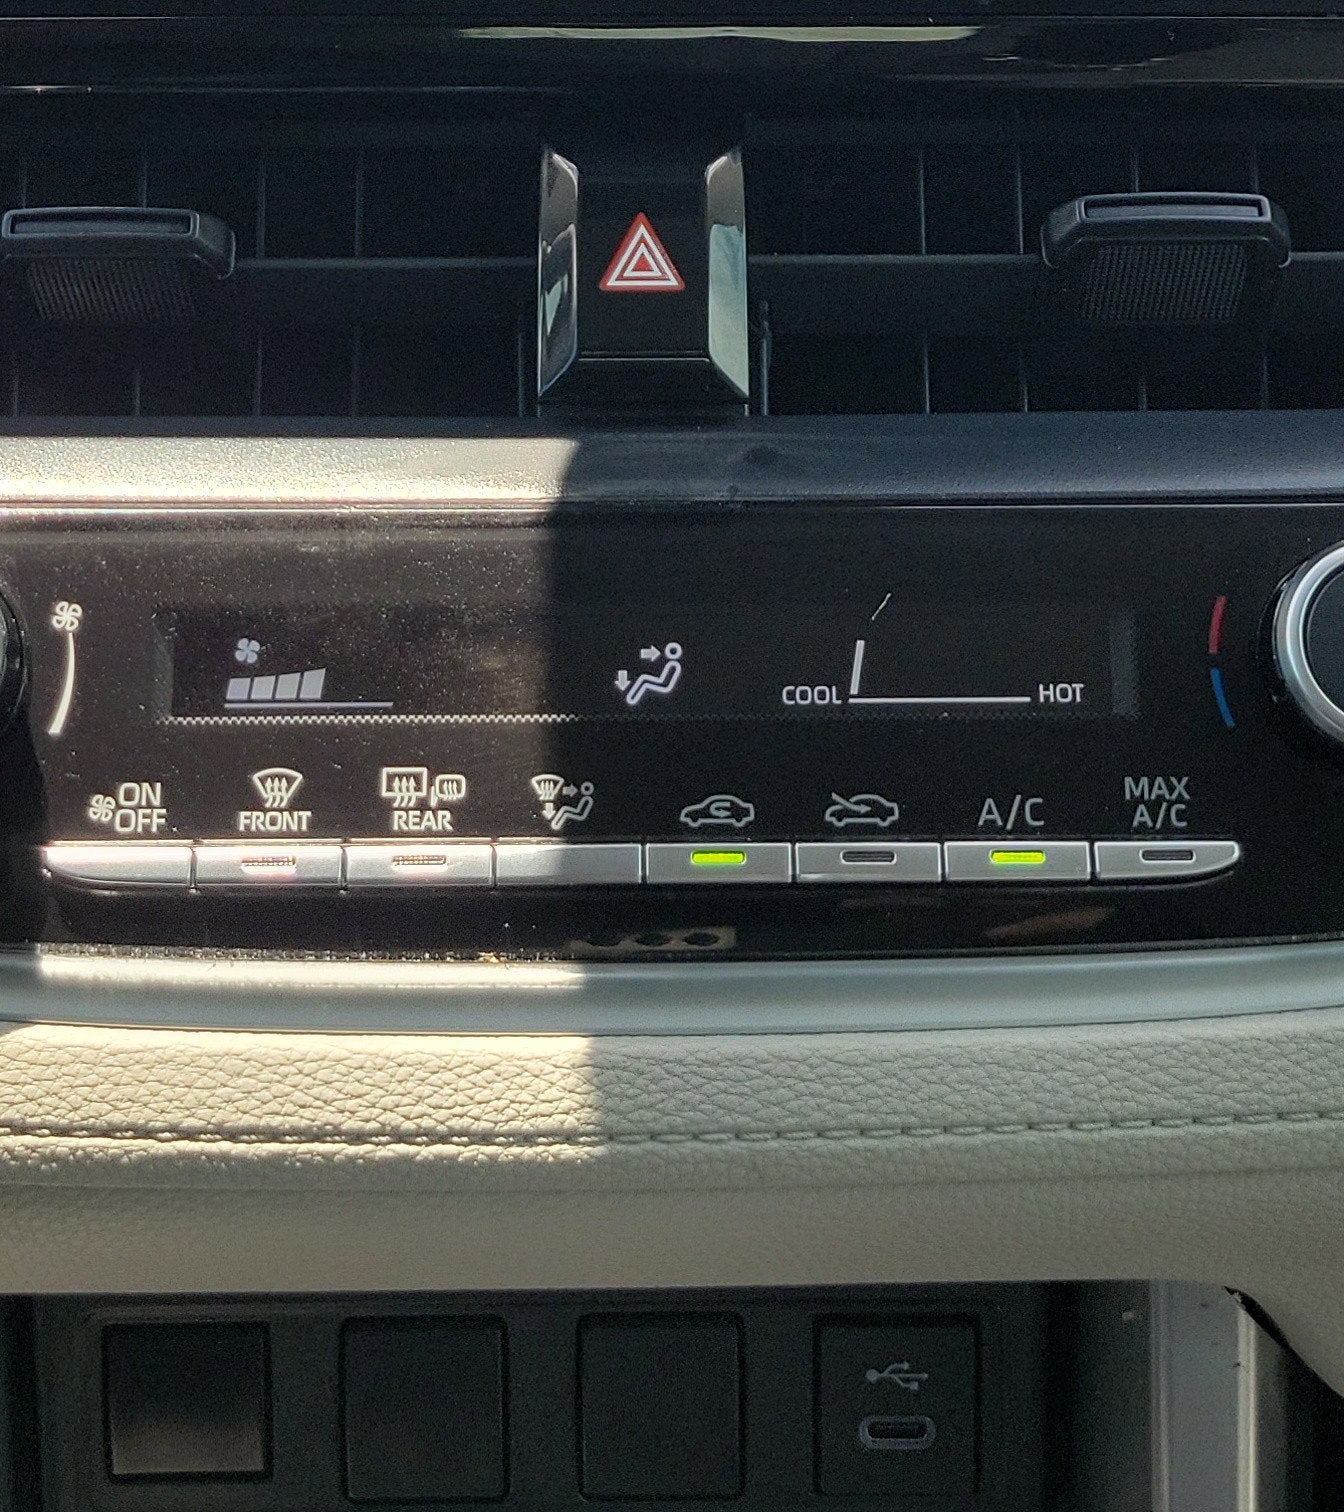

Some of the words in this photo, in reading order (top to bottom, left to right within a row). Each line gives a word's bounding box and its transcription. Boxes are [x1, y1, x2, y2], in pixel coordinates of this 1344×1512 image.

[782, 685, 841, 706] COOL
[1038, 683, 1084, 703] HOT
[118, 781, 162, 808] ON
[1124, 776, 1190, 801] MAX
[113, 808, 167, 833] OFF
[238, 809, 312, 832] FRONT
[392, 809, 453, 832] REAR
[977, 794, 1045, 829] A/C
[1132, 803, 1188, 829] A/C
